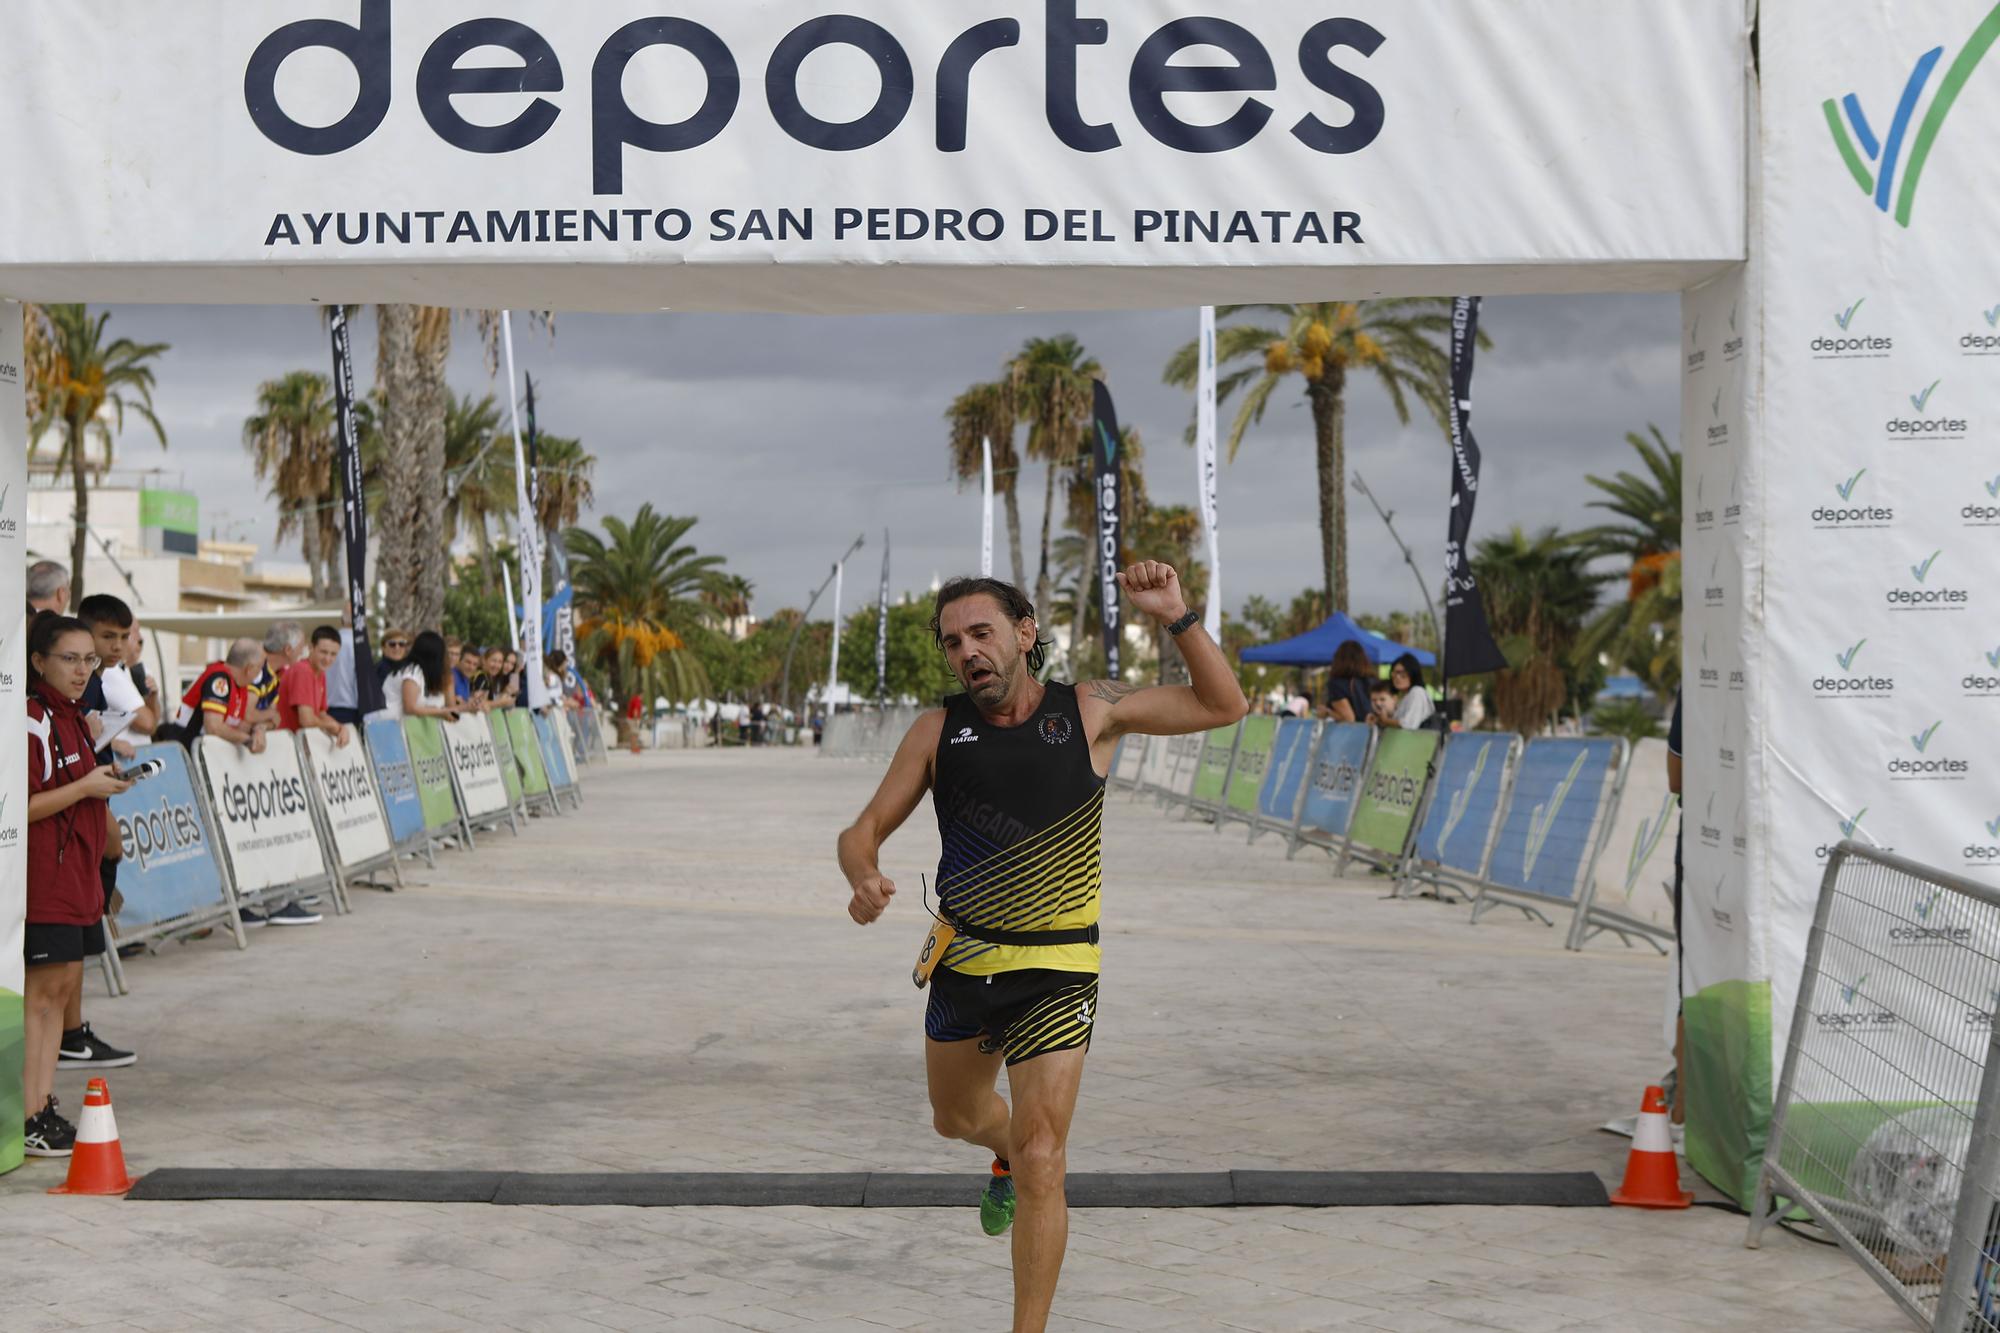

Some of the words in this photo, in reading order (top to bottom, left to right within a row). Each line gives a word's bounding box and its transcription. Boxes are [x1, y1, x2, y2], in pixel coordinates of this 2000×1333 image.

[244, 0, 1387, 195] deportes
[264, 208, 692, 246] AYUNTAMIENTO
[709, 208, 813, 242] SAN
[834, 207, 1001, 242] PEDRO
[1024, 209, 1116, 242] DEL
[1134, 210, 1365, 245] PINATAR
[1810, 336, 1893, 354] deportes
[1886, 417, 1967, 436] deportes
[1811, 506, 1894, 524] deportes
[1961, 504, 2000, 522] dep
[1886, 588, 1968, 606] deportes
[1812, 676, 1894, 694] deportes
[1962, 675, 2000, 692] dep
[950, 735, 979, 745] VIATOR
[1888, 758, 1969, 775] deportes
[223, 769, 306, 833] deportes
[119, 796, 201, 869] eportes
[1963, 845, 2000, 862] dep
